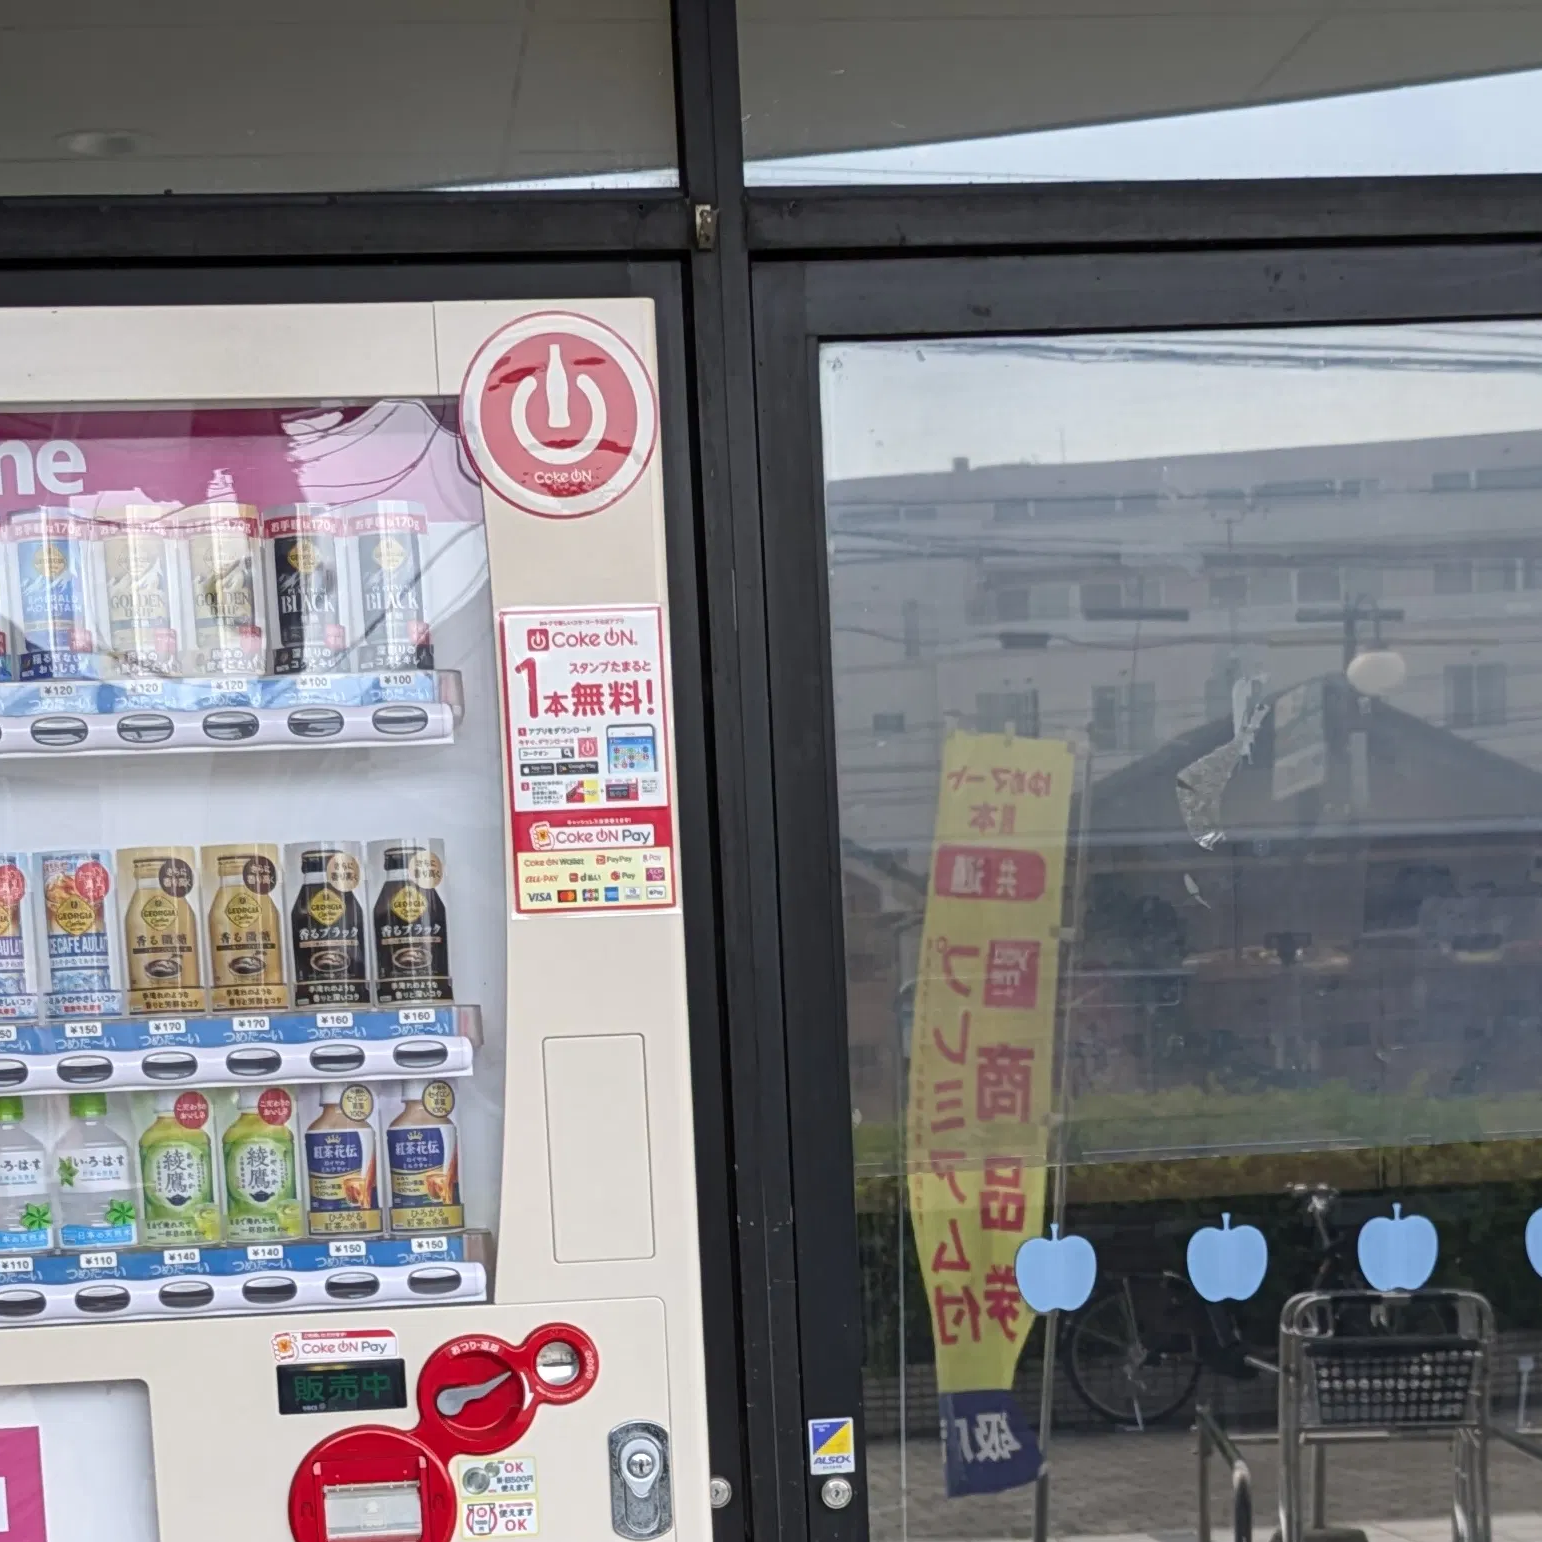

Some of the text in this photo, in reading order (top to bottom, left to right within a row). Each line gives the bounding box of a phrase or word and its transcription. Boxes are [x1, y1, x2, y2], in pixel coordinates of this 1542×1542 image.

[534, 470, 569, 484] Coke
[551, 626, 634, 648] Coke ON
[569, 660, 652, 675] スタンプたまると
[555, 830, 594, 844] Coke
[621, 829, 651, 845] Pay
[606, 855, 633, 864] PayPay
[526, 892, 553, 903] VISA
[298, 926, 359, 941] 香るブラック
[380, 924, 442, 939] 香るブラック
[319, 1013, 350, 1026] ¥160
[401, 1010, 432, 1022] ¥160
[152, 1020, 183, 1033] ¥170
[236, 1017, 267, 1030] ¥170
[68, 1024, 100, 1037] ¥150
[313, 1145, 358, 1159] 紅茶花伝
[395, 1141, 440, 1155] 紅茶花伝
[162, 1148, 188, 1194] 綾鷹
[246, 1145, 272, 1191] 綾鷹
[328, 1211, 363, 1223] ひろがる
[410, 1207, 445, 1219] ひろがる
[333, 1242, 363, 1255] ¥150
[415, 1238, 445, 1251] ¥150
[167, 1250, 197, 1263] ¥140
[251, 1246, 281, 1259] ¥140
[0, 1259, 31, 1272] ¥110
[83, 1255, 114, 1267] ¥110
[301, 1341, 336, 1355] Coke
[361, 1340, 388, 1355] Pay
[293, 1374, 392, 1402] 販売中
[504, 1461, 524, 1474] OK
[501, 1483, 530, 1493] 使えます
[498, 1507, 534, 1519] 使えます
[504, 1519, 528, 1532] OK
